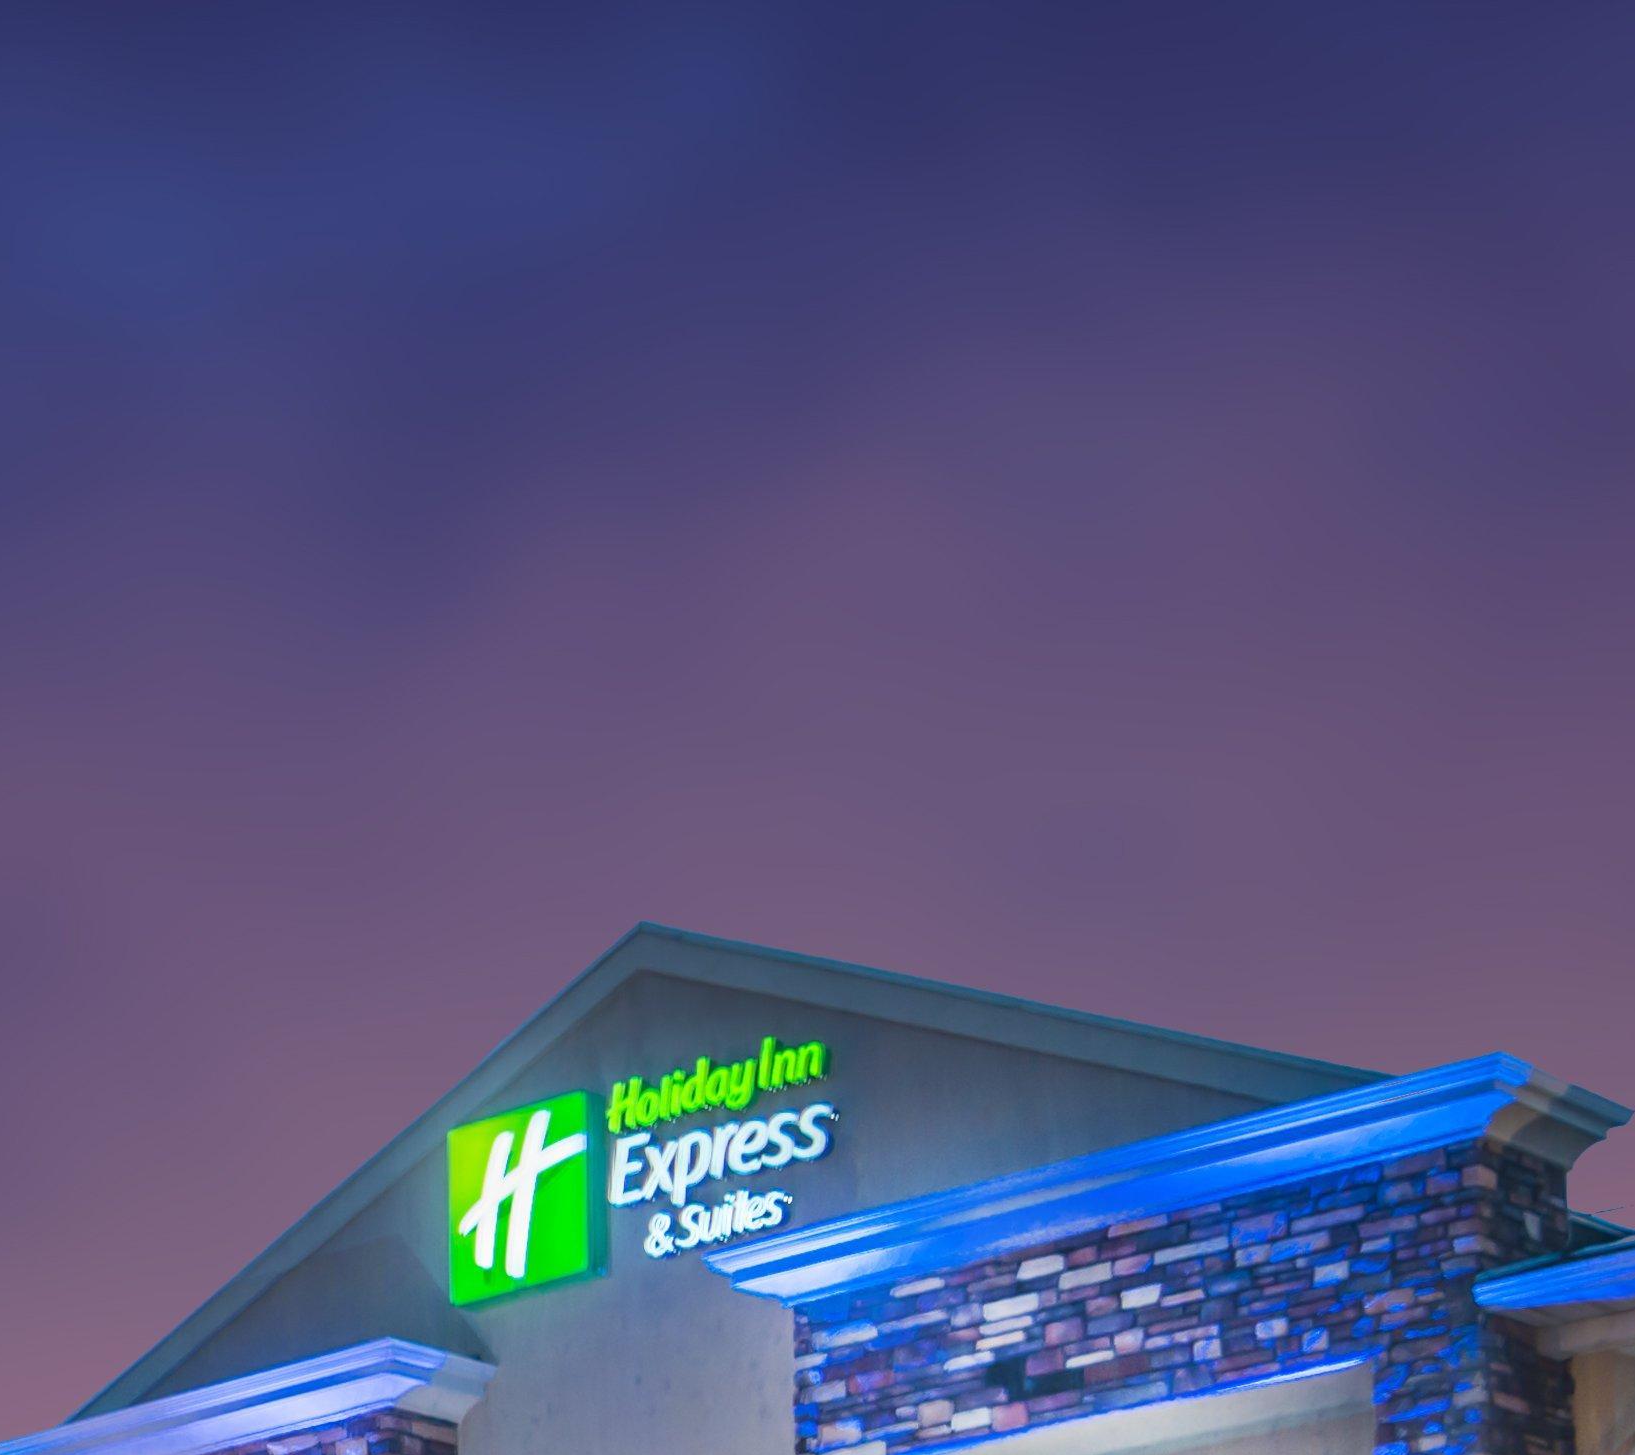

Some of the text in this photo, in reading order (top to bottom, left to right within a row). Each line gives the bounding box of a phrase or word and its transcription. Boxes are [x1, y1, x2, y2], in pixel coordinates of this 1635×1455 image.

[607, 1036, 826, 1134] Holiday Inn
[608, 1103, 833, 1208] Express
[644, 1190, 785, 1258] & Suites
